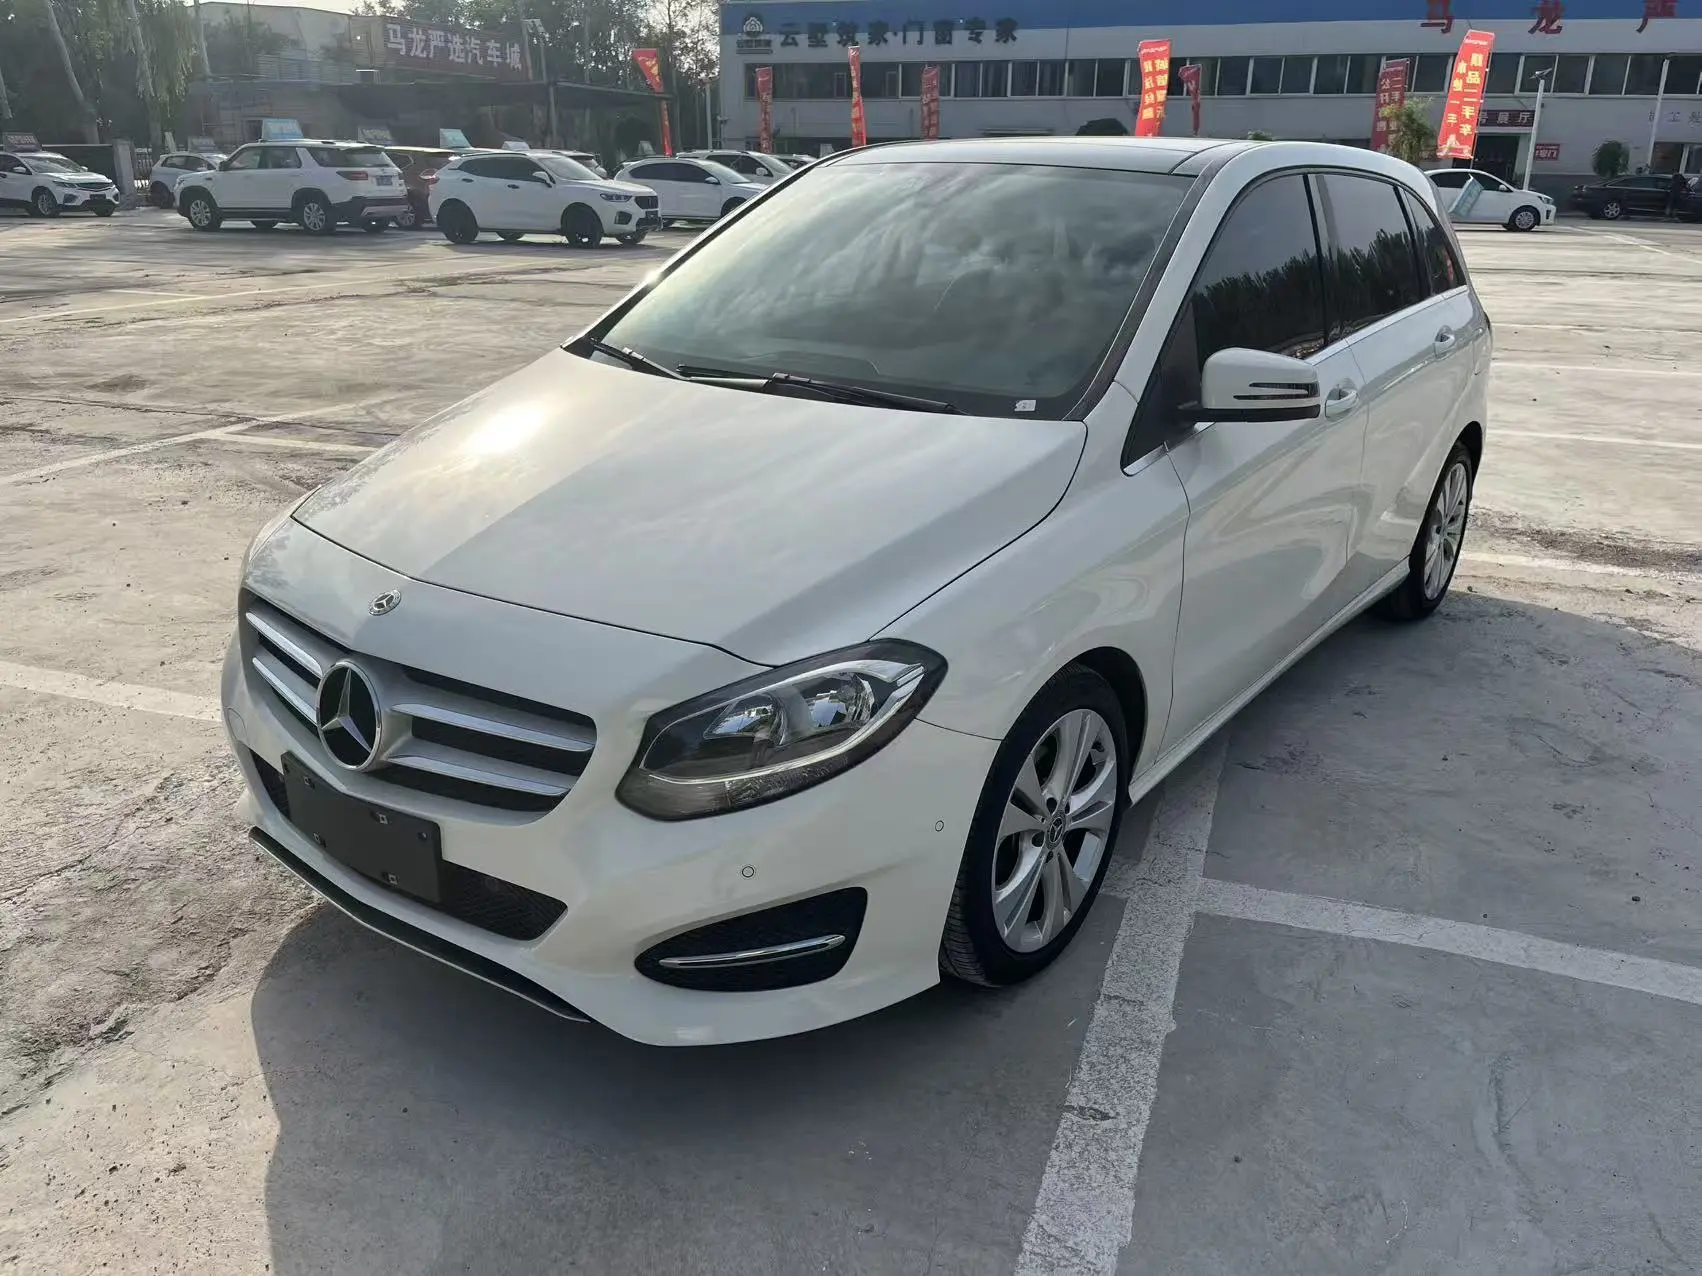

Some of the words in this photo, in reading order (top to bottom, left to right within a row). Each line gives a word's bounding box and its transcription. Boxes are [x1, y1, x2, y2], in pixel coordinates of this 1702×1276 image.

[386, 23, 522, 73] 马龙严选汽车城
